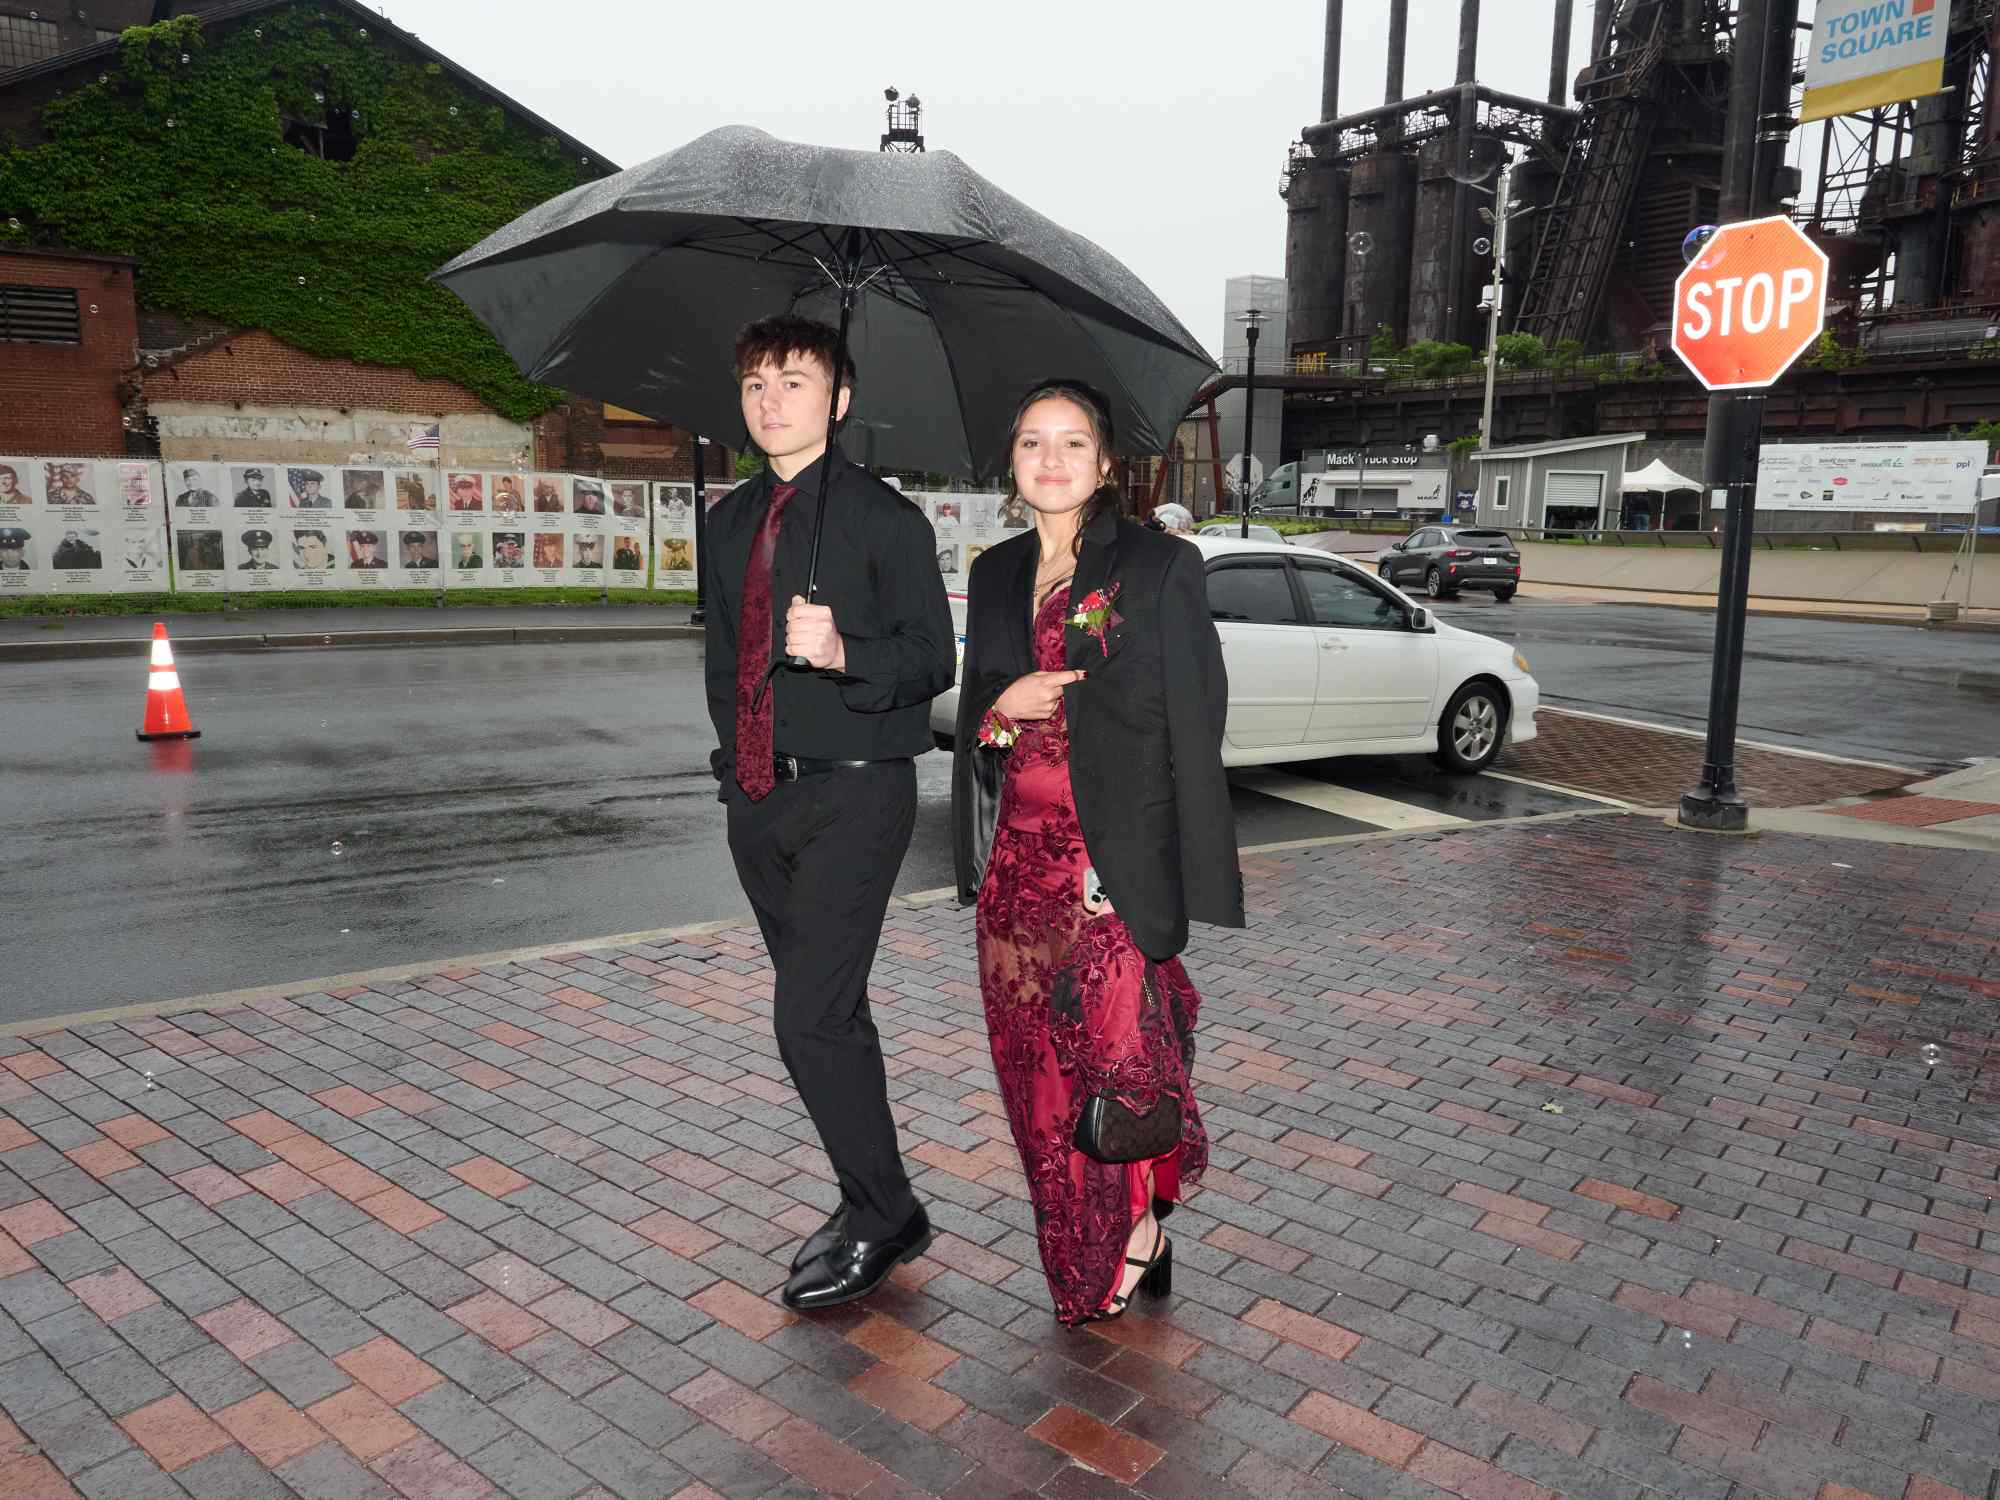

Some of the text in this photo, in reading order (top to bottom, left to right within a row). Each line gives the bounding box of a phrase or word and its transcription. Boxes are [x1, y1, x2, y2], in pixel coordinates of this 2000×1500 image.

[1820, 15, 1935, 64] SQUARE
[1826, 0, 1905, 39] TOWN
[1683, 267, 1814, 341] STOP
[1327, 453, 1355, 465] Mack
[1358, 454, 1389, 465] ruck
